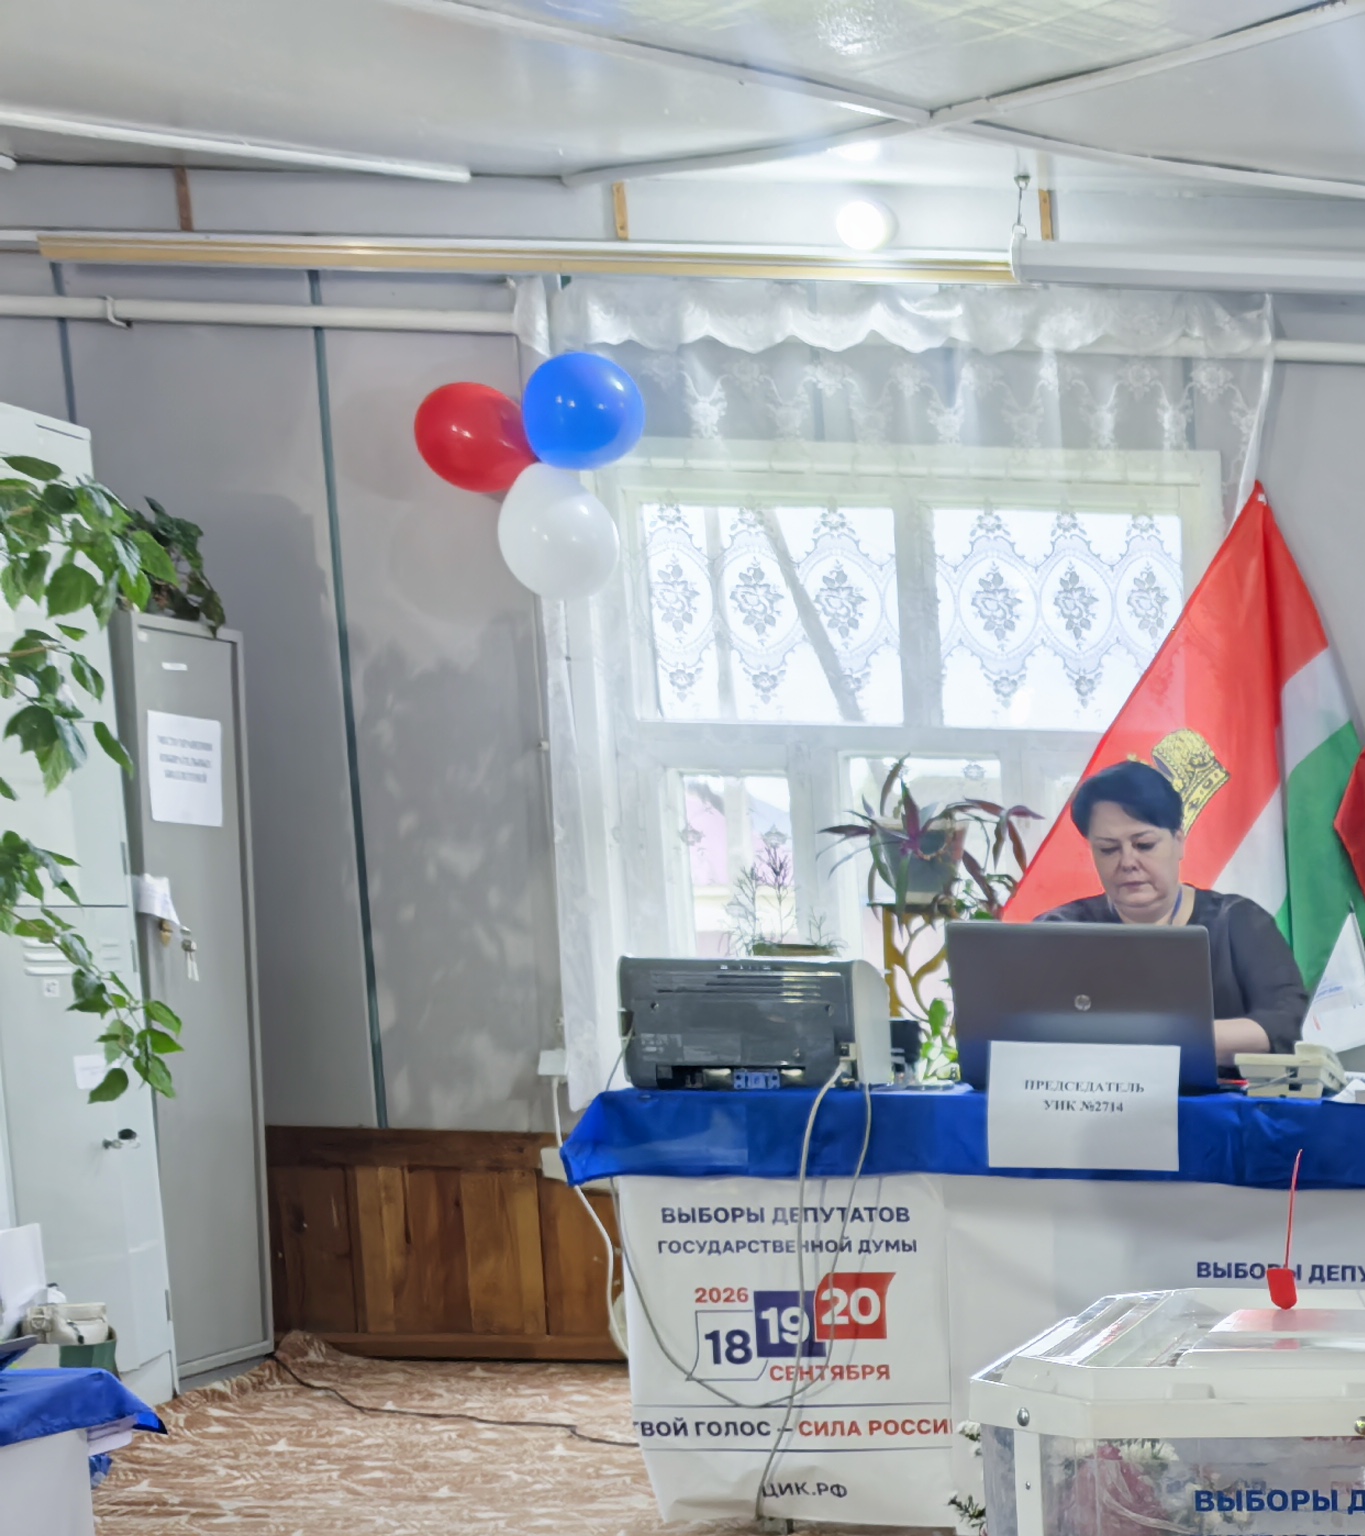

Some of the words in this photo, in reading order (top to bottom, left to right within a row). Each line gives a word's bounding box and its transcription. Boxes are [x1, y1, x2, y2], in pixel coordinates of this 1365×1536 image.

[1023, 1079, 1145, 1093] ПРЕДСЕДАТЕЛЬ
[1043, 1099, 1077, 1112] УИК
[1079, 1100, 1124, 1113] №2714
[660, 1206, 765, 1224] ВЫБОРЫ
[772, 1206, 910, 1226] ДЕПУТАТОВ
[858, 1238, 917, 1255] ДУМЫ
[694, 1286, 750, 1304] 2026
[820, 1286, 882, 1326] 20
[704, 1328, 754, 1365] 18
[760, 1305, 811, 1345] 19
[769, 1364, 891, 1382] СЕНТЯБРЯ
[633, 1416, 689, 1437] ВОЙ
[695, 1420, 772, 1437] ГОЛОС
[798, 1419, 862, 1437] СИЛА
[762, 1482, 848, 1499] ЦИК.РФ
[1194, 1489, 1338, 1513] ВЫБОРЫ
